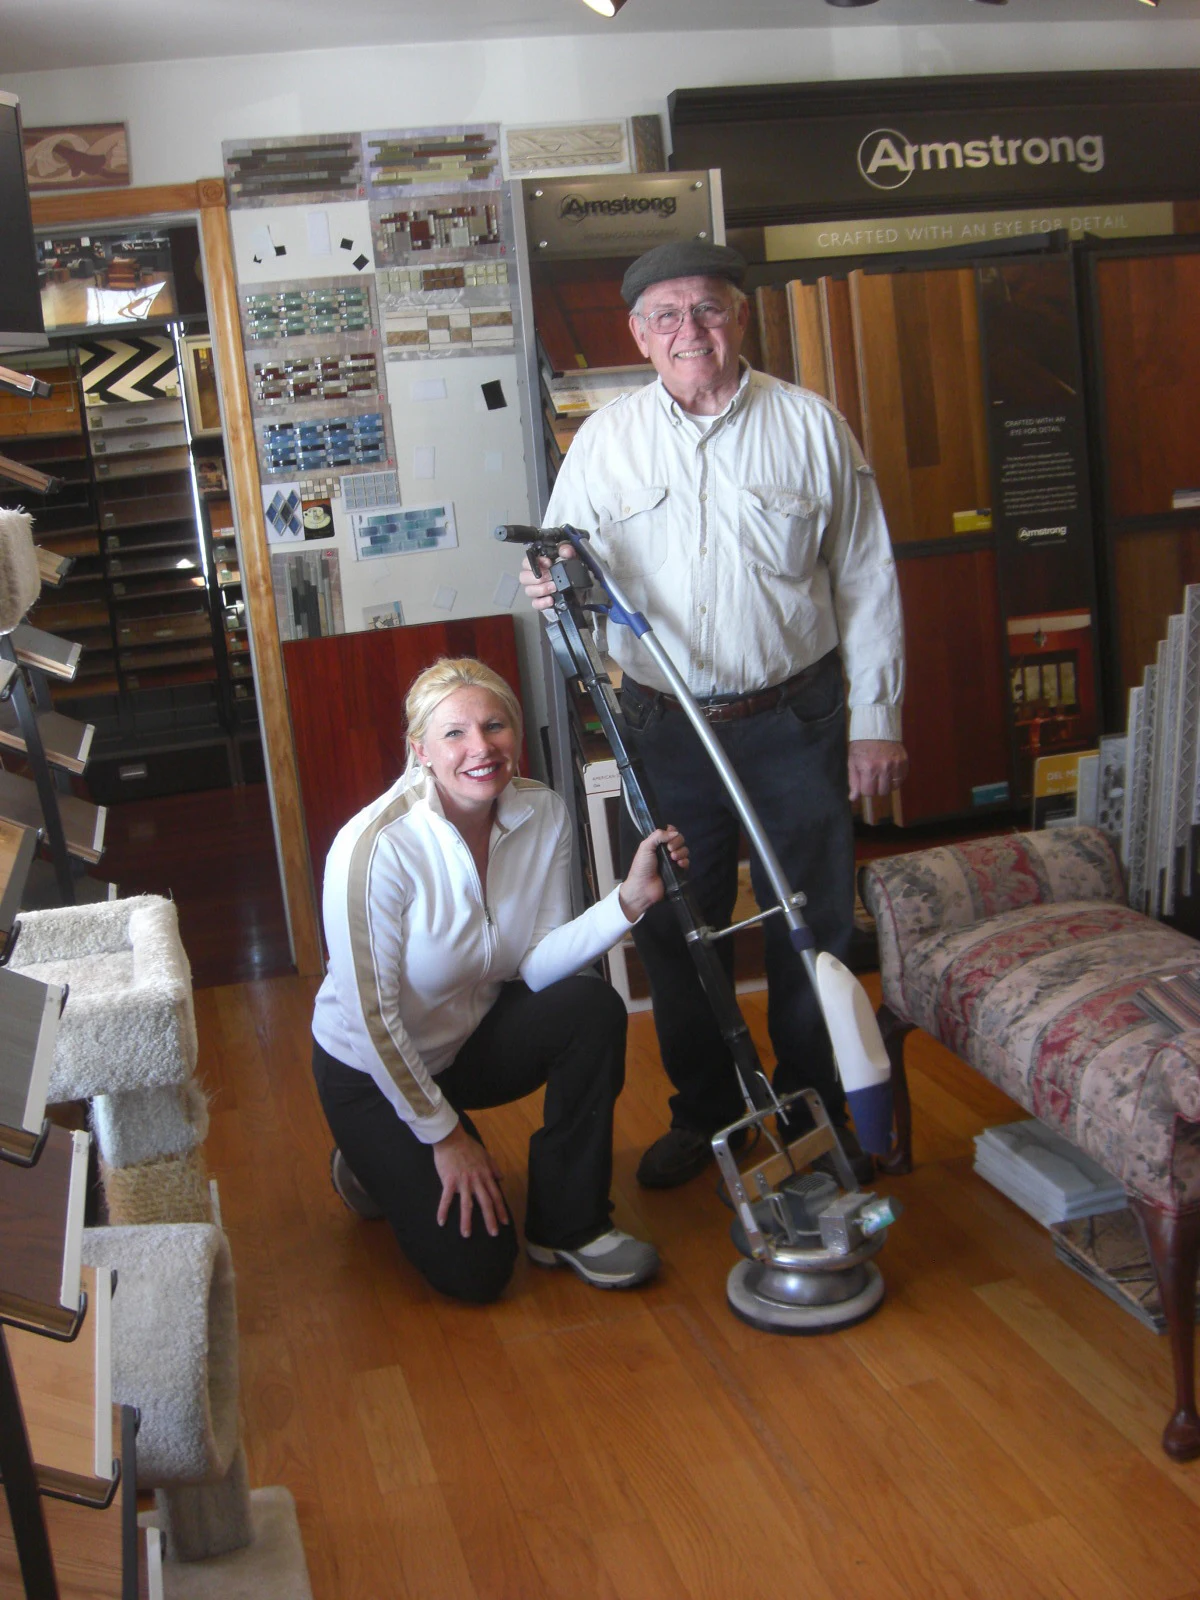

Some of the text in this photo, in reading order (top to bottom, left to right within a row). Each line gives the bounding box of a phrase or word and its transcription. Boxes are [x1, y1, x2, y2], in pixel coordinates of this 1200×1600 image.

[863, 133, 1104, 177] Armstrong
[560, 195, 677, 219] Armstrong
[817, 215, 1128, 248] CRAFTED WITH AN EYE FOR DETAIL
[1004, 418, 1035, 428] CRAFTED
[1036, 416, 1054, 424] WITH
[1019, 526, 1067, 540] Armstrong
